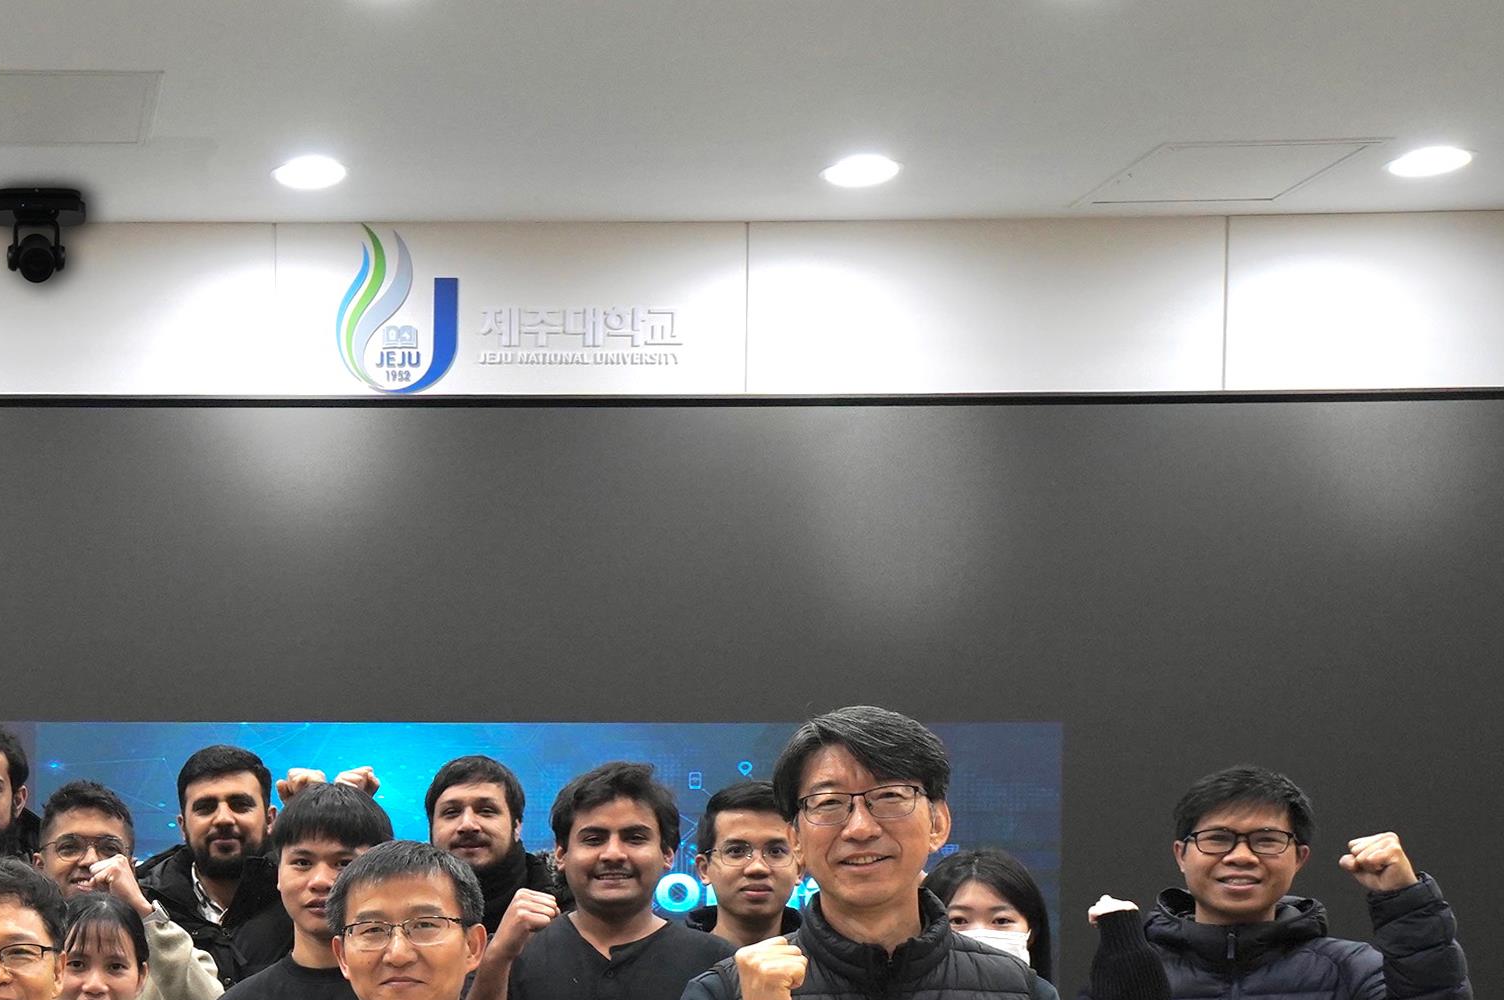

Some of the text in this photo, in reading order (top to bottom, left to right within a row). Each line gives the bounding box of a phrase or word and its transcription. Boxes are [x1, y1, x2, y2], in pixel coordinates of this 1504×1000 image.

[480, 306, 684, 348] 제주대학교
[376, 351, 421, 368] JEJU
[479, 351, 679, 365] JEJU NATIONAL UNIVERSITY
[385, 370, 411, 382] 1952
